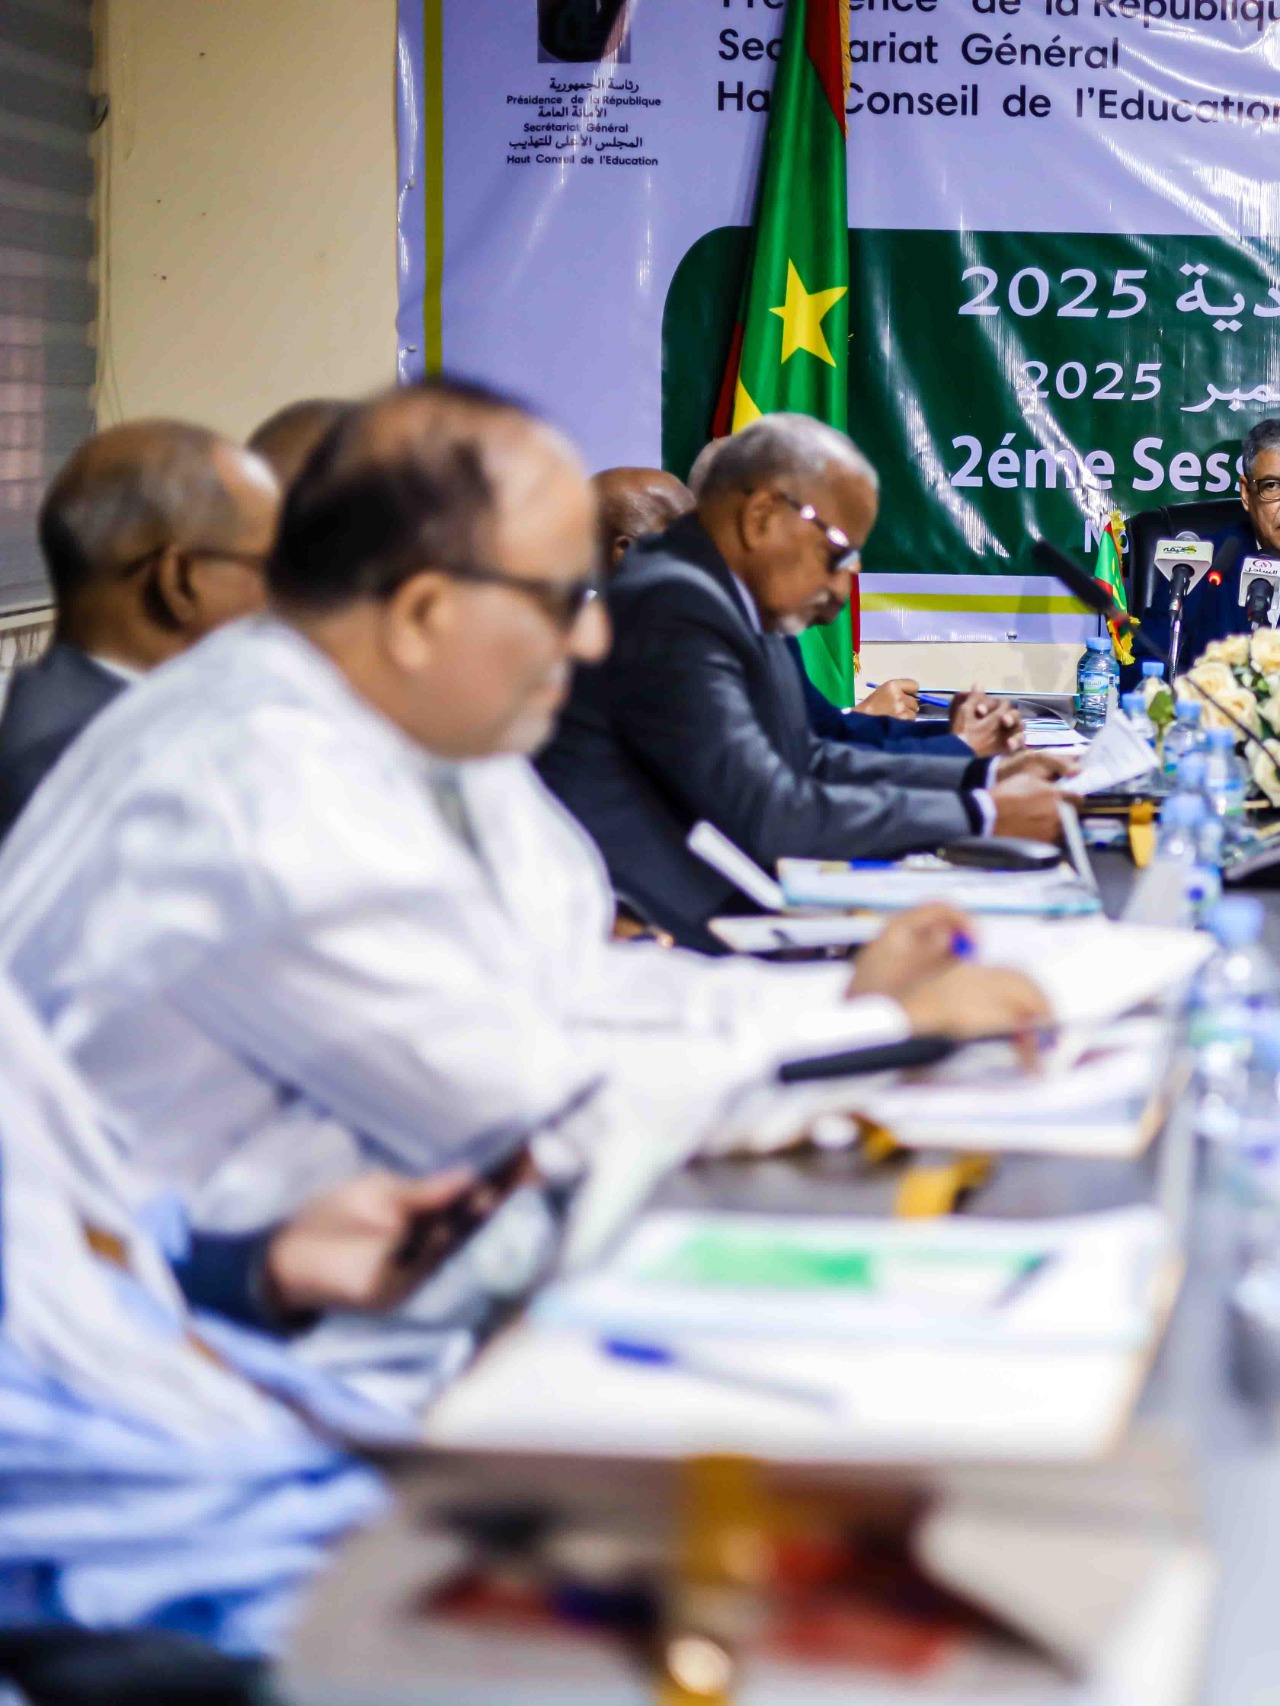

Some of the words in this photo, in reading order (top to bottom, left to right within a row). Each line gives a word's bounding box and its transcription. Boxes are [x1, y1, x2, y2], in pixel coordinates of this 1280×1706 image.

[718, 28, 938, 63] Secariat
[961, 33, 1118, 68] Général
[550, 77, 604, 92] الجمهورية
[608, 79, 639, 93] رئاسة
[506, 95, 562, 105] Présidence
[571, 95, 584, 104] de
[603, 95, 662, 107] République
[717, 81, 770, 112] Ha
[846, 82, 978, 116] Conseil
[1003, 85, 1051, 117] de
[538, 106, 568, 118] العامة
[524, 123, 580, 133] Secrétariat
[586, 123, 628, 133] Général
[509, 136, 552, 150] للتهذيب
[595, 137, 643, 151] المجلس
[507, 155, 530, 165] Haut
[536, 154, 575, 165] Conseil
[581, 155, 594, 165] de
[958, 266, 1147, 319] 2025
[1018, 361, 1162, 401] 2025
[950, 433, 1115, 490] 2éme
